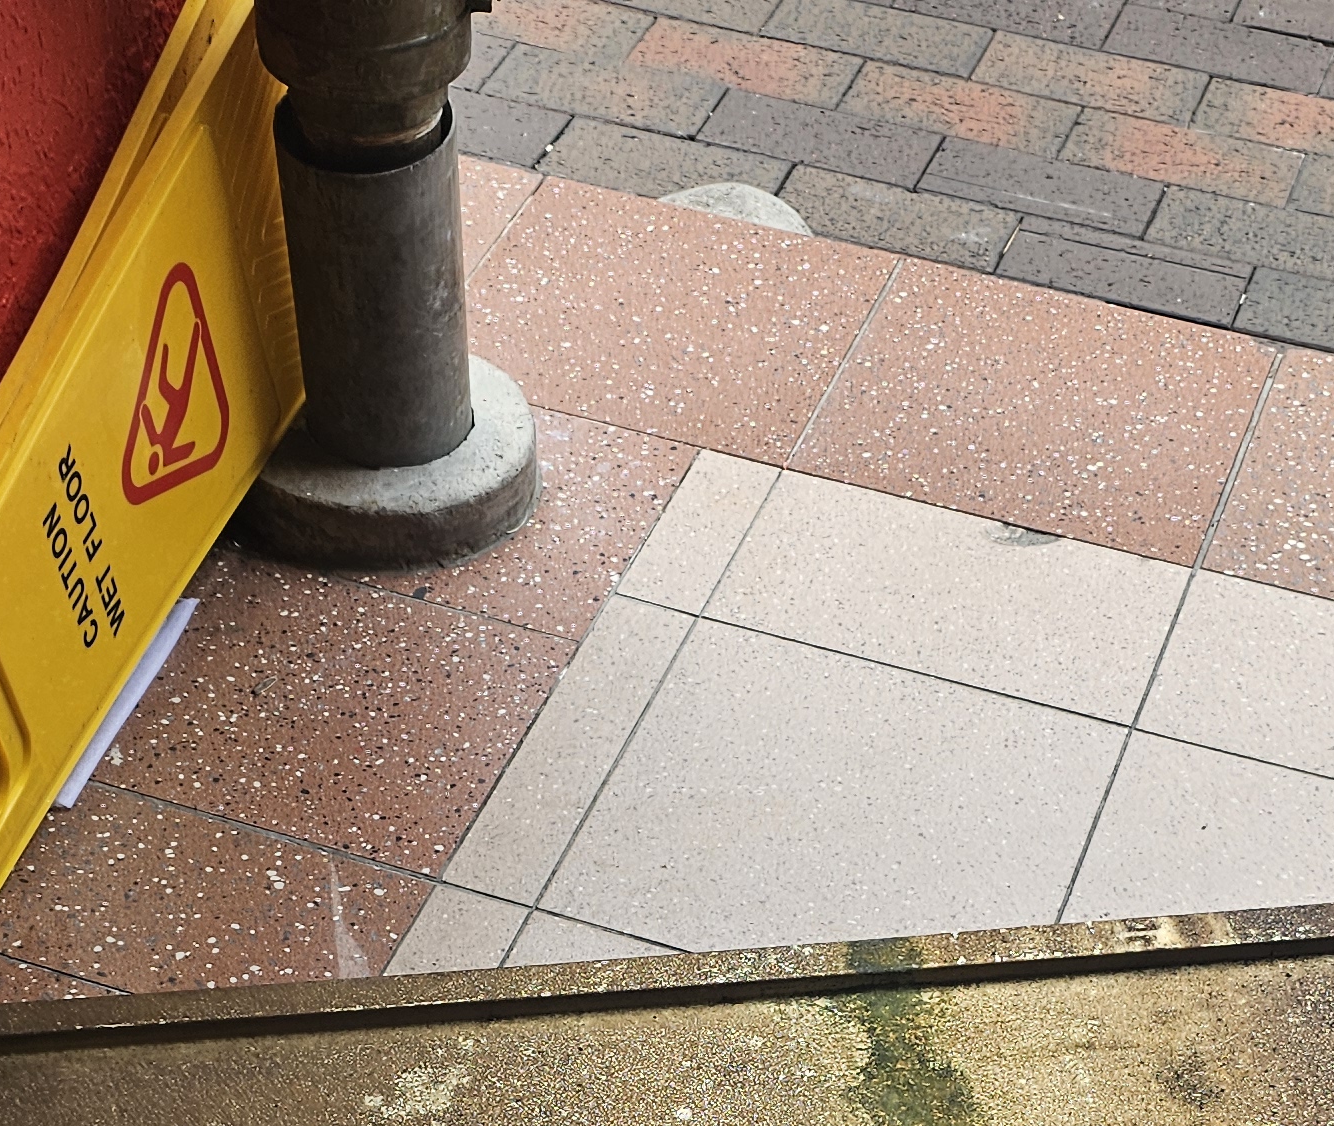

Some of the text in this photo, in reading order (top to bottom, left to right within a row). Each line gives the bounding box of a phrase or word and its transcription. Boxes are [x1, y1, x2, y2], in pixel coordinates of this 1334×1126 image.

[42, 502, 98, 648] CAUTION
[58, 443, 125, 638] WET FLOOR
